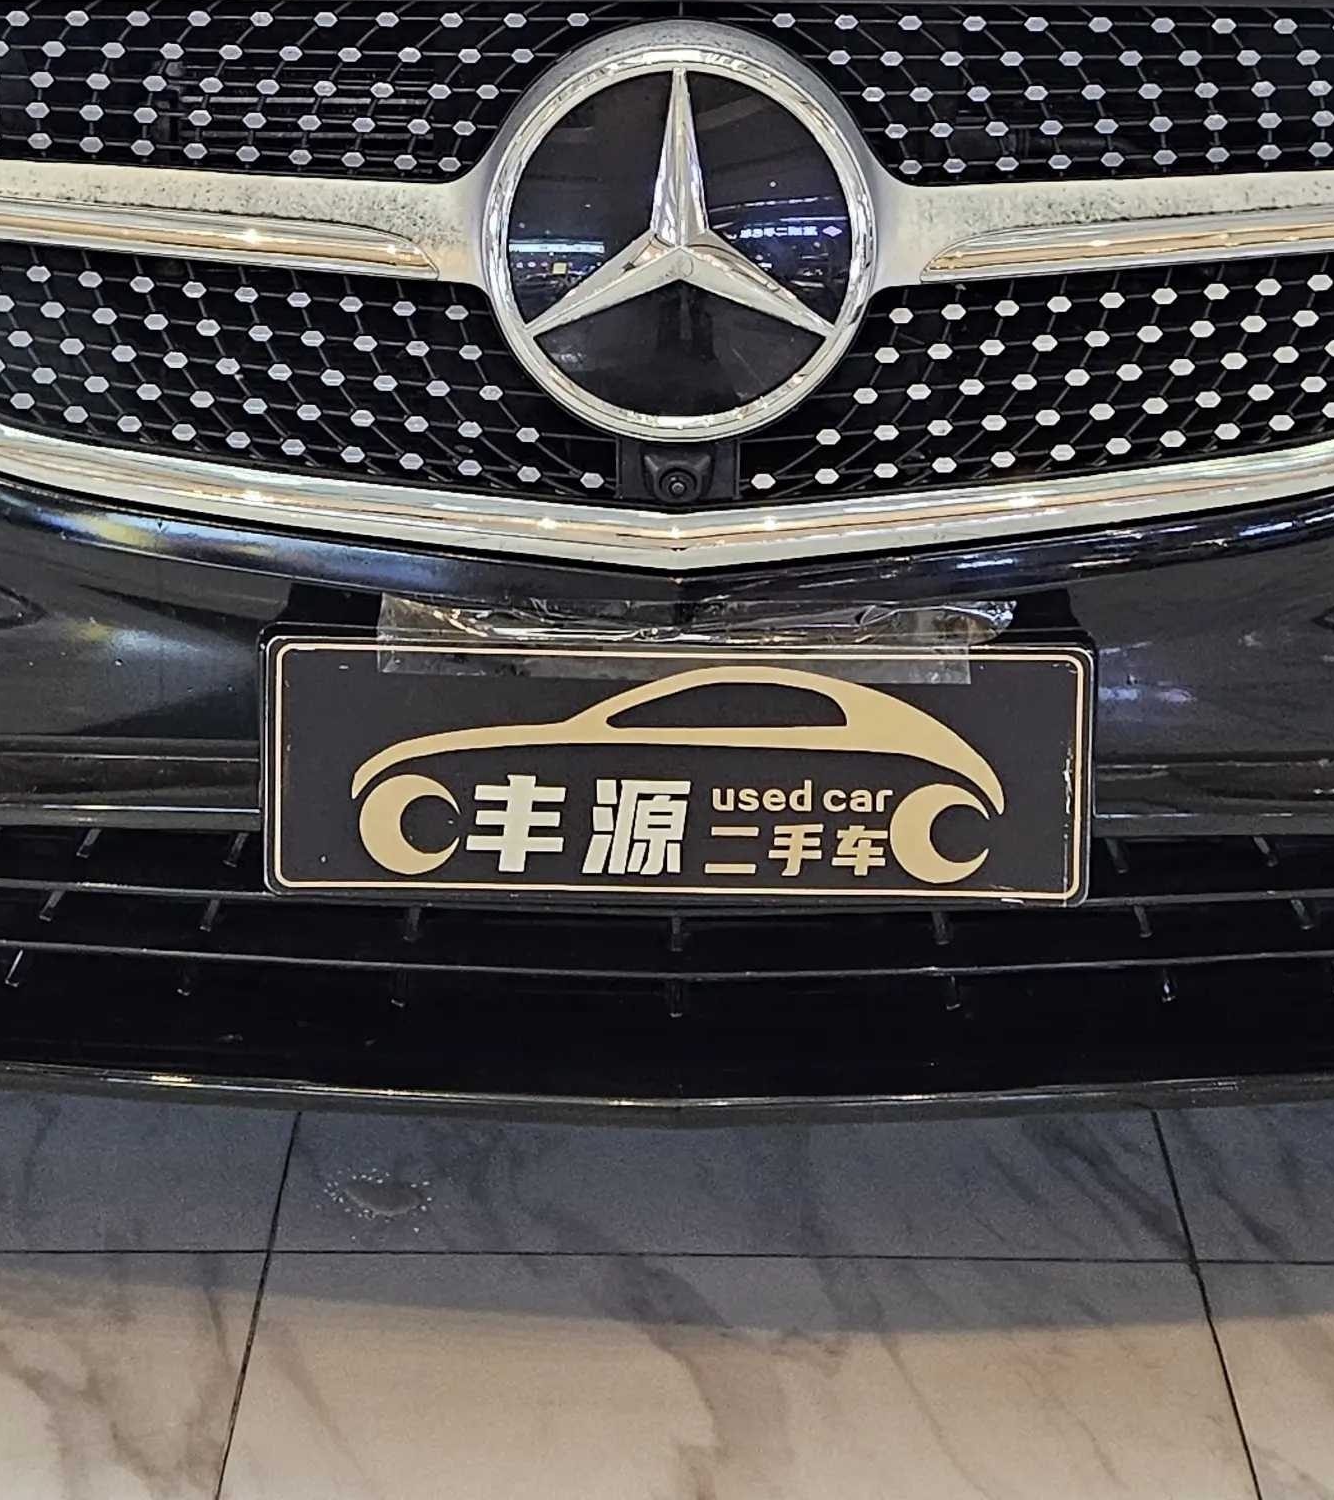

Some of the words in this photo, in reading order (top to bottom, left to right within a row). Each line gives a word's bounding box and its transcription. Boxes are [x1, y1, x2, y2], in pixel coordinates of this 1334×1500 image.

[712, 780, 812, 812] used
[823, 789, 893, 813] car
[466, 774, 691, 875] 丰源
[704, 823, 888, 877] 二手车
